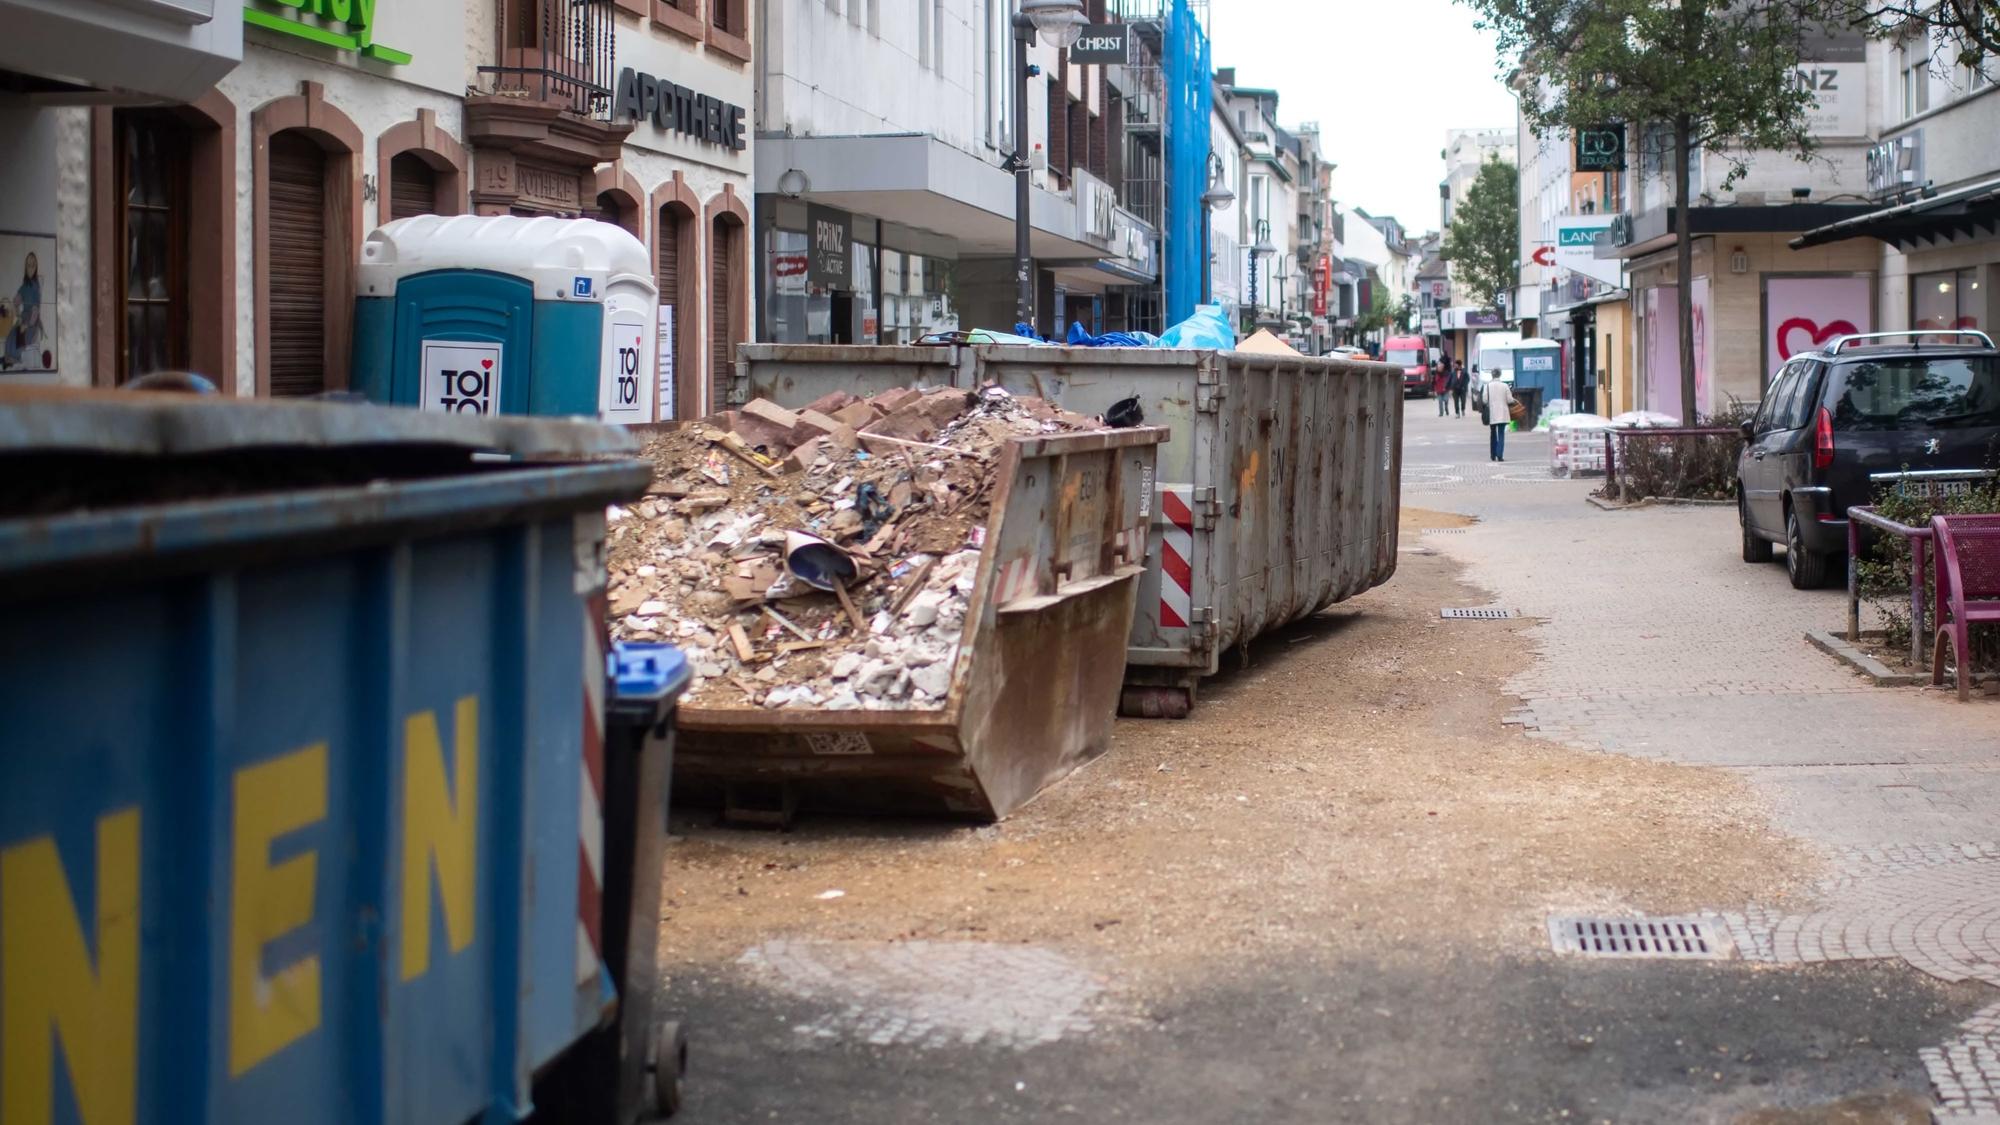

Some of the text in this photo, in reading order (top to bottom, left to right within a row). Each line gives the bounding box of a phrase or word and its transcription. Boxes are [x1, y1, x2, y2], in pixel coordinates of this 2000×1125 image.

[1076, 36, 1123, 51] CHRIST
[614, 67, 747, 151] APOTHEKE
[617, 376, 639, 405] TOI
